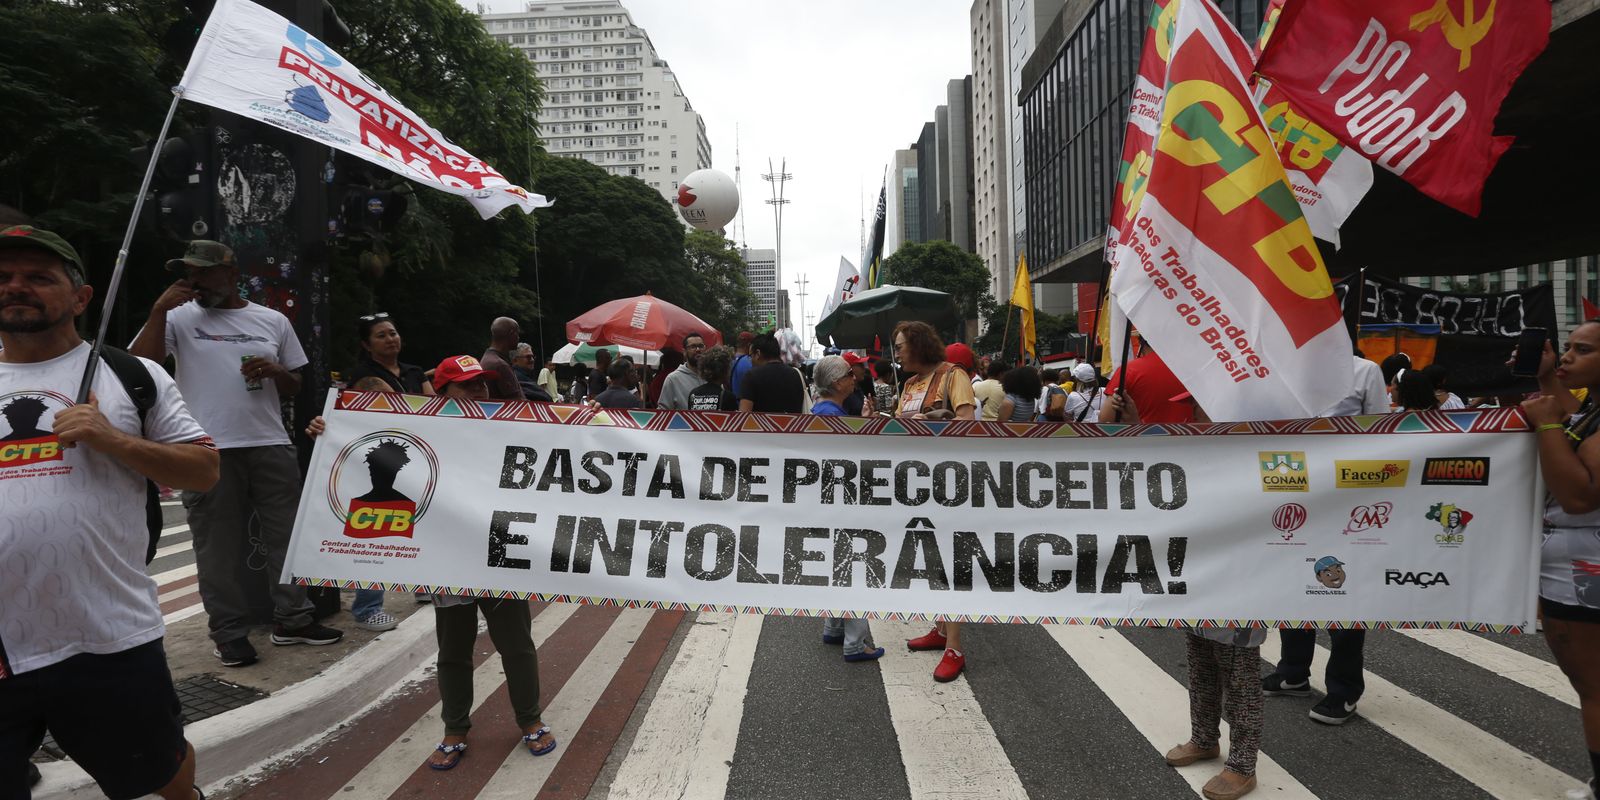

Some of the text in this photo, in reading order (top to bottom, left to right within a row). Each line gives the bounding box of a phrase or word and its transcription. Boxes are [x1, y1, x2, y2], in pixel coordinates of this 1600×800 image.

[1137, 215, 1270, 379] dos Trabalhadores
[1176, 301, 1201, 327] do
[1199, 326, 1251, 384] Brasil
[0, 441, 59, 462] CTB
[21, 465, 73, 474] Trabalhadores
[498, 445, 1188, 510] BASTA DE PRECONCEITO
[1341, 468, 1391, 483] Facesp
[1427, 460, 1485, 480] UNEGRO
[1263, 475, 1308, 485] CONAM
[350, 506, 412, 532] CTB
[321, 540, 421, 553] Central dos Trabalhadores
[328, 547, 382, 557] Trabalhadoras
[487, 510, 1188, 595] E INTOLERÂNCIA!
[1385, 571, 1451, 590] RAÇA
